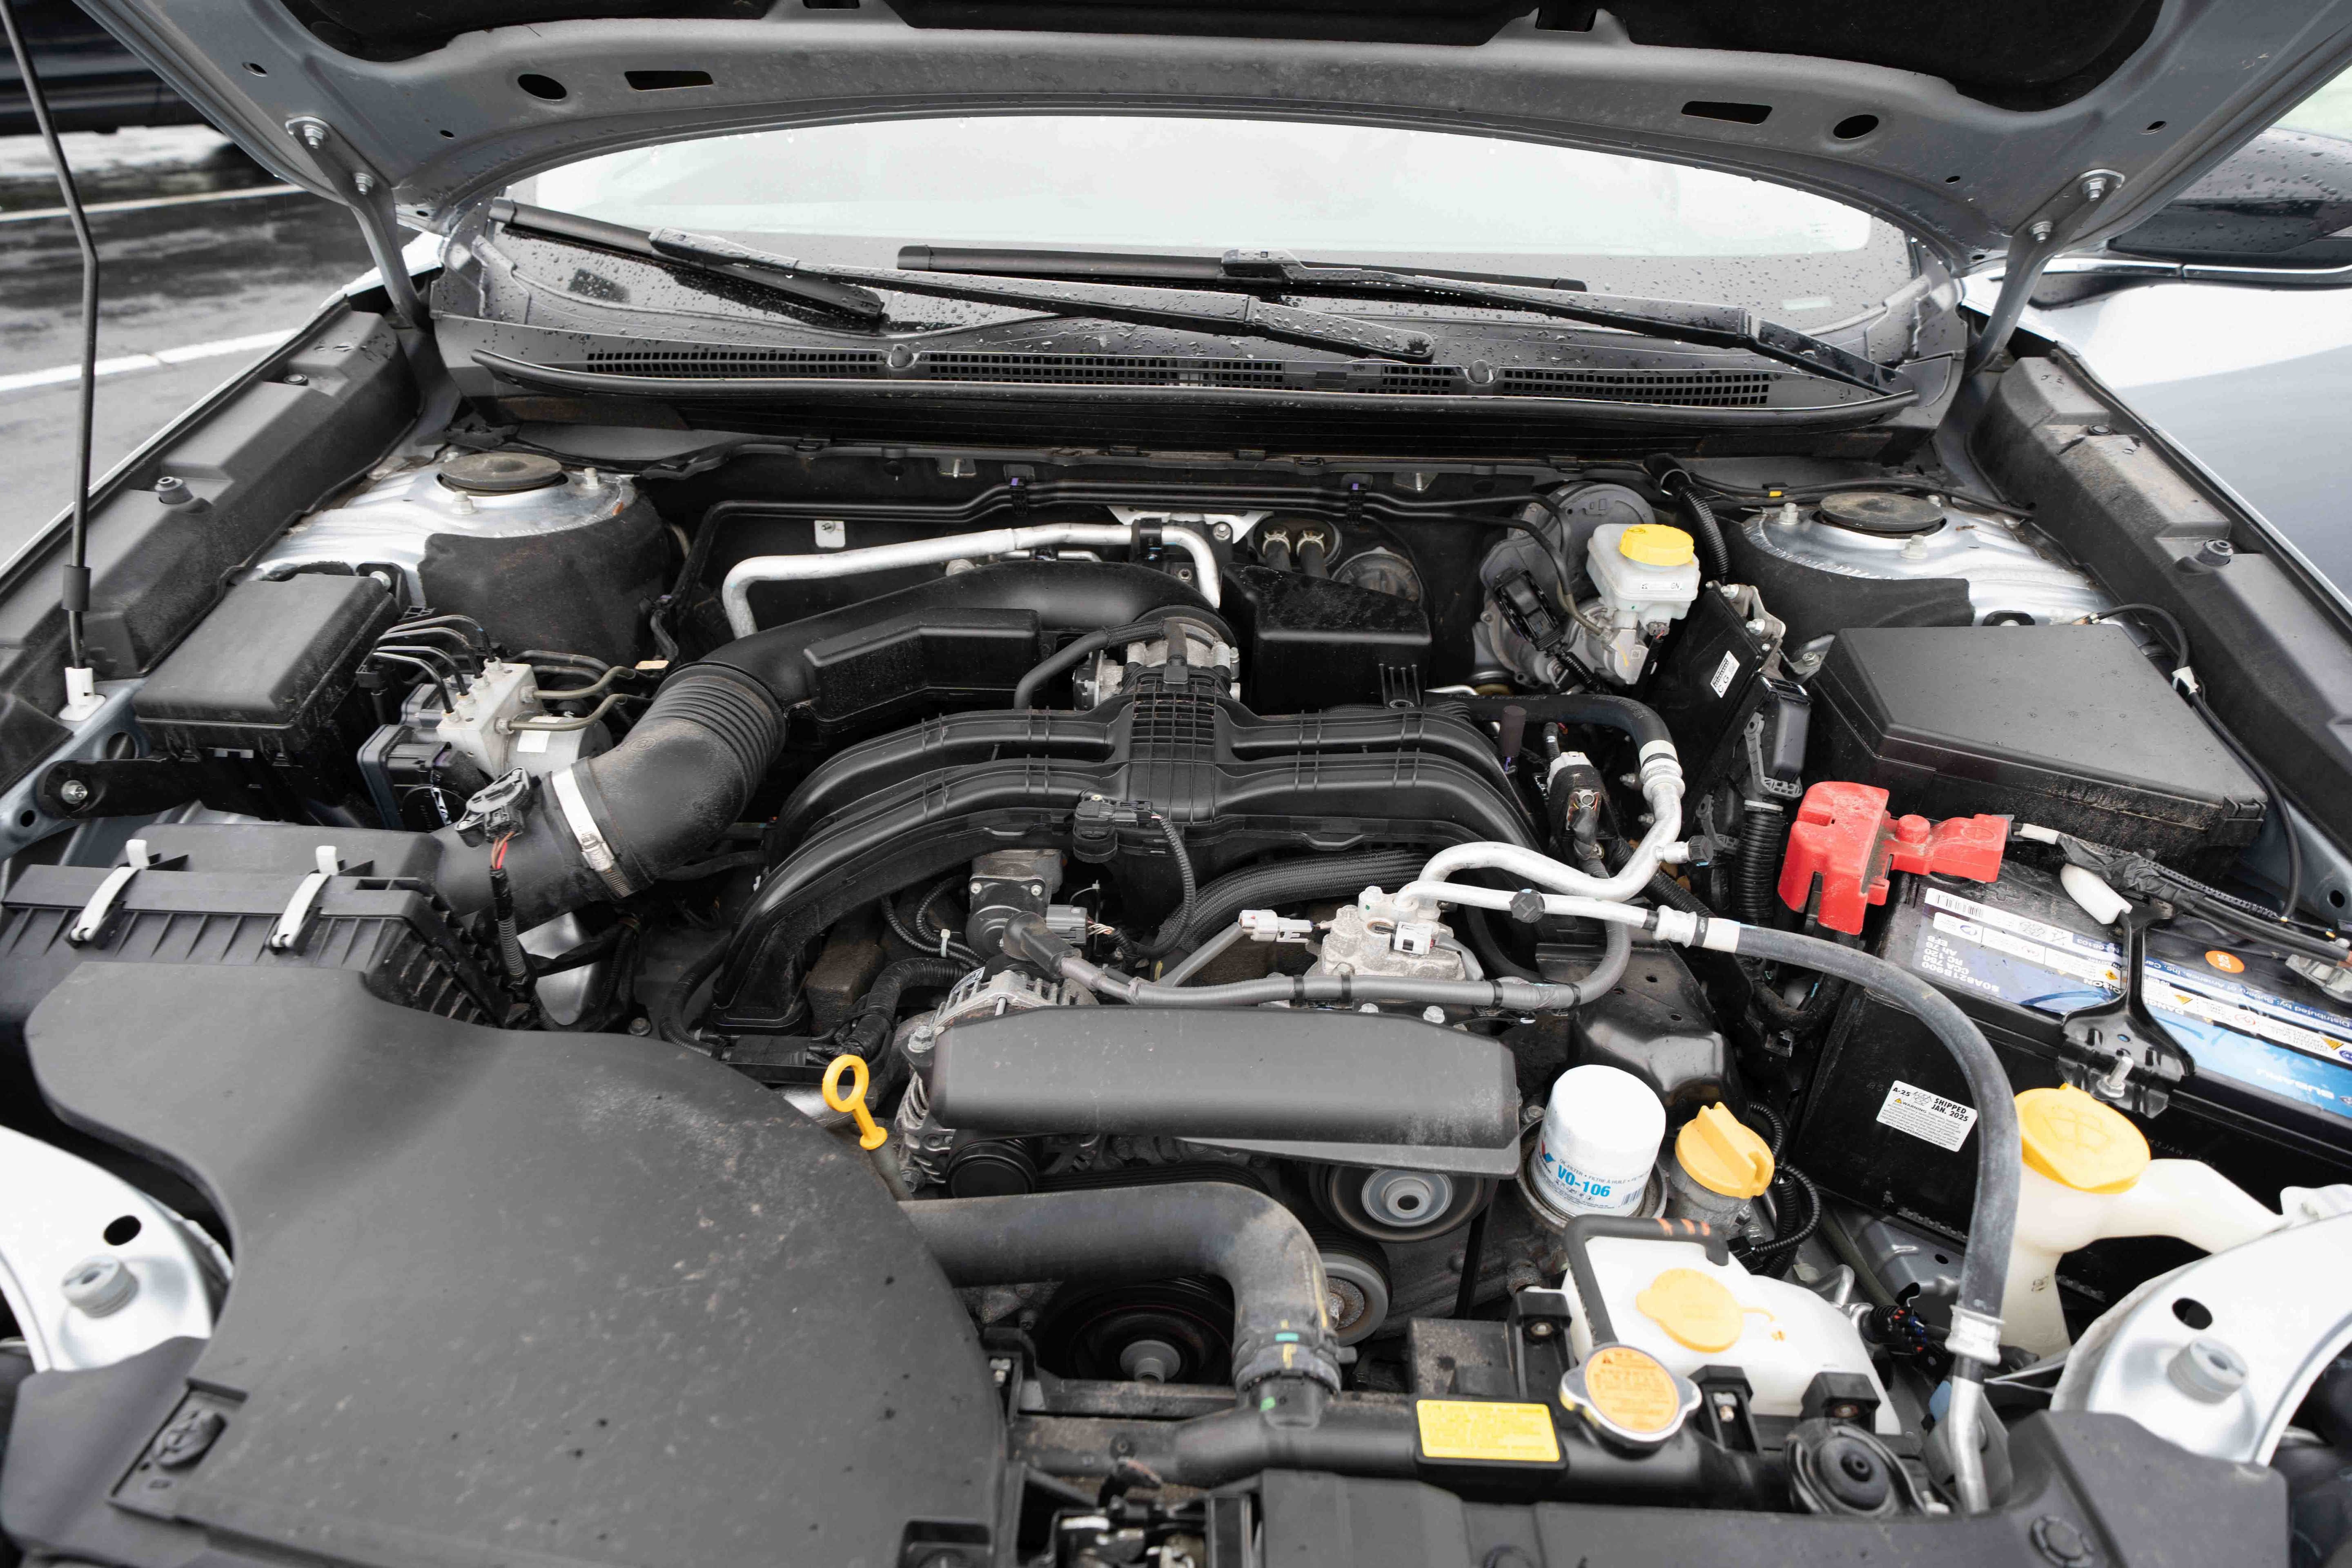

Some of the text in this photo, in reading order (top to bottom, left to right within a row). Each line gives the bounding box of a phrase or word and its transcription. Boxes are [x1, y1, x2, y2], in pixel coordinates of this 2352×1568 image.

[2083, 978, 2121, 994] OISON
[2294, 1006, 2350, 1027] Distributed
[1893, 1087, 1967, 1114] A-25 SHIPPED
[1902, 1102, 1927, 1113] WARNING
[1931, 1105, 1969, 1122] JAN. 2025
